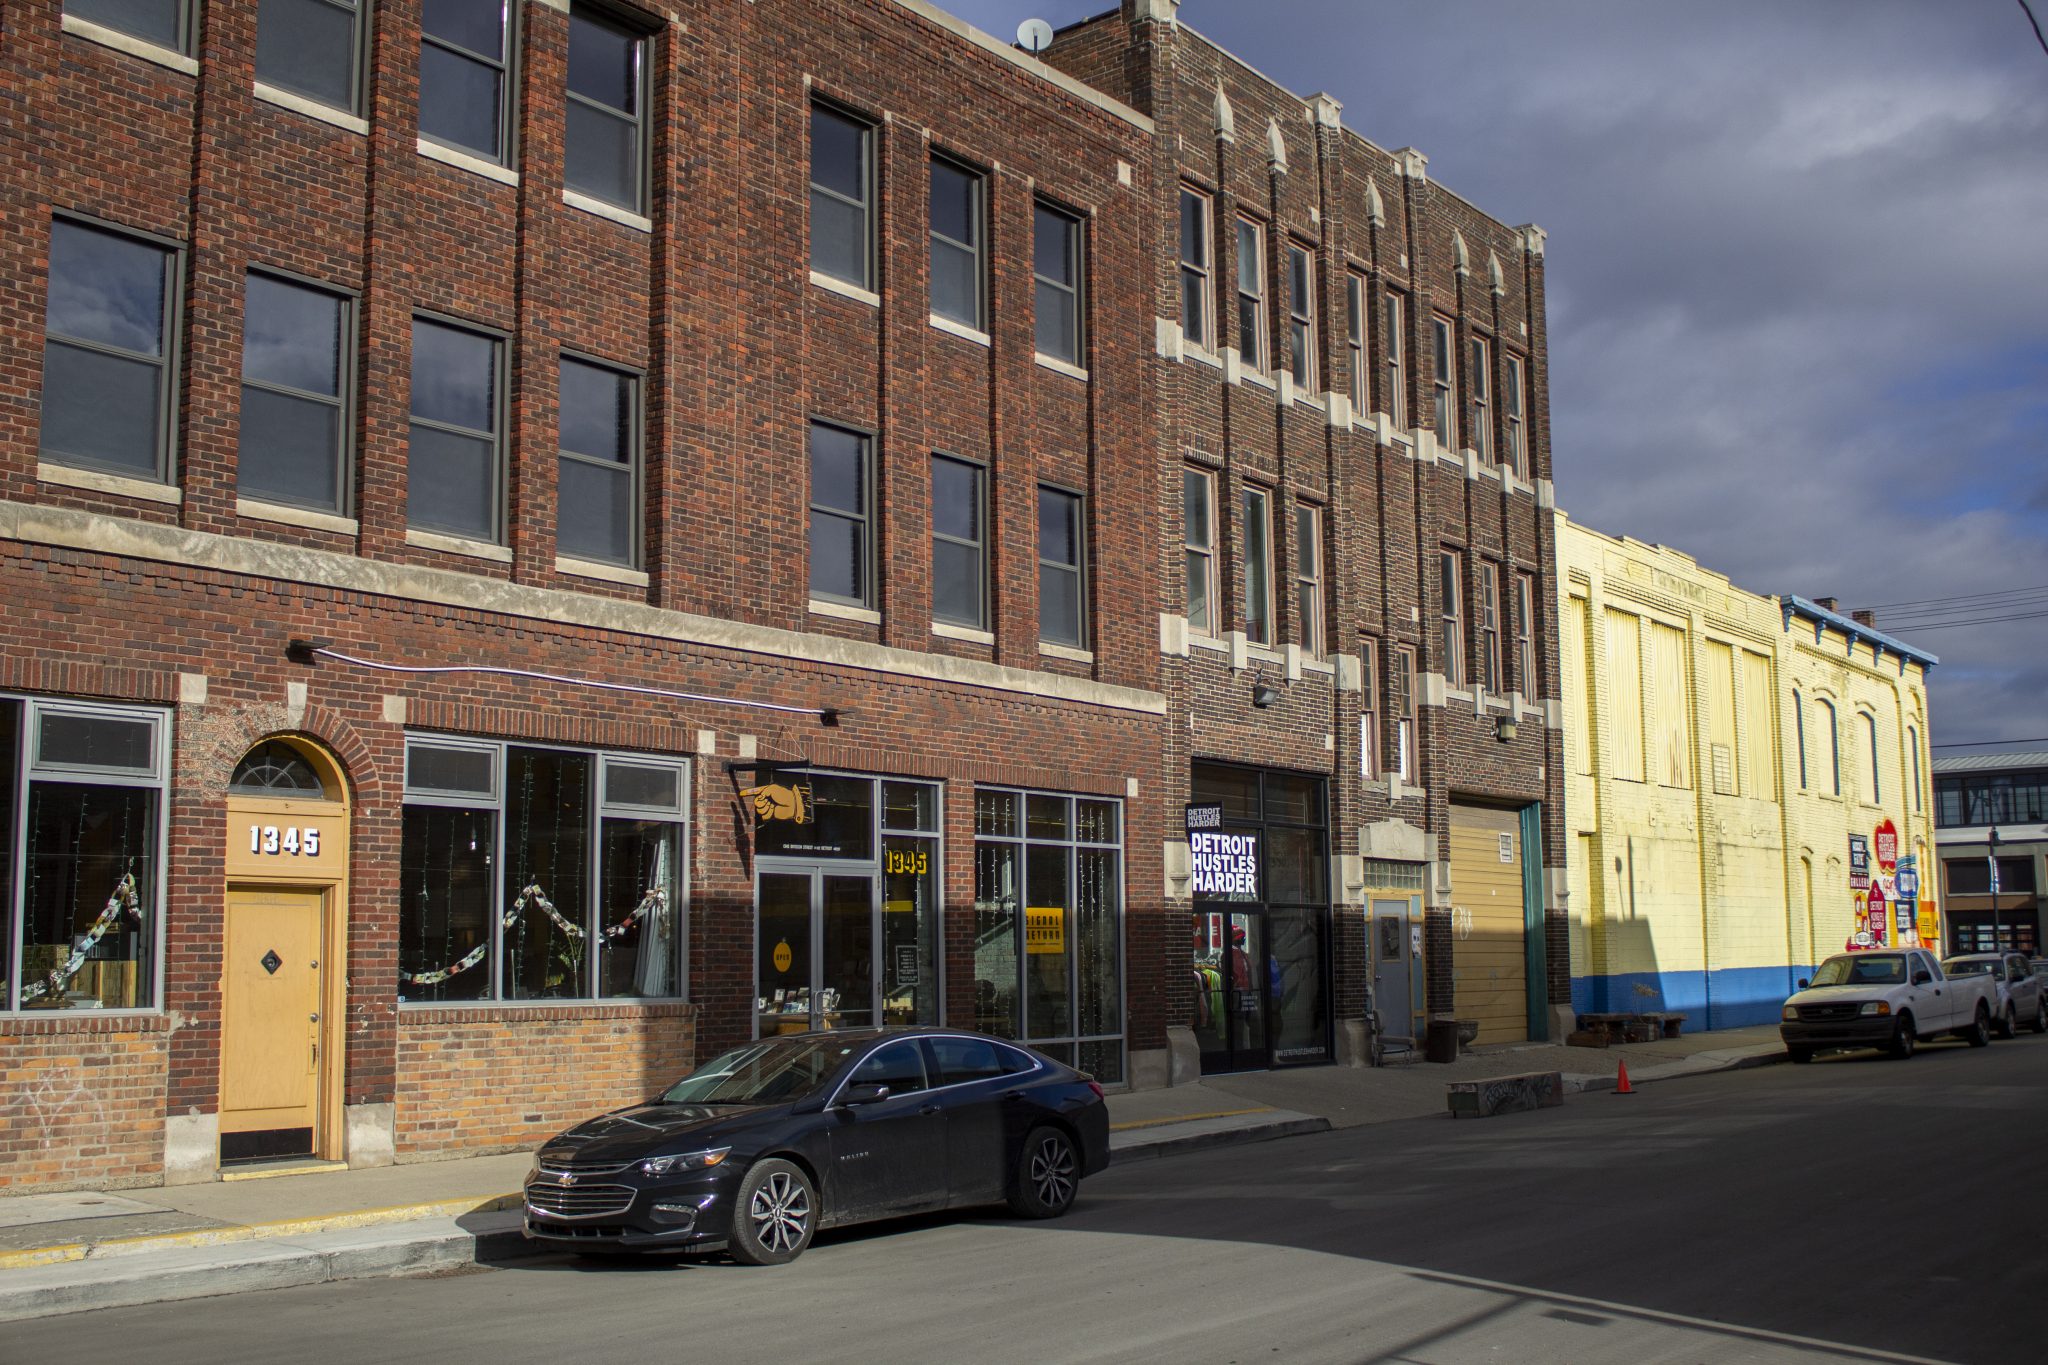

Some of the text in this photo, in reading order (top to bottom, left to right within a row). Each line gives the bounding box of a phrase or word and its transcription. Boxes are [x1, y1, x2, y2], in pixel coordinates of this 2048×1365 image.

[1188, 807, 1220, 816] DETROIT
[1188, 813, 1220, 821] HUSTLES
[250, 825, 320, 857] 1345
[1191, 832, 1256, 856] DETROIT
[886, 850, 927, 874] 1345
[1192, 852, 1256, 874] HUSTLES
[1192, 871, 1256, 893] HARDER
[1026, 915, 1059, 926] SIGNAL
[1026, 930, 1060, 940] RETURN
[776, 953, 790, 961] OPEN
